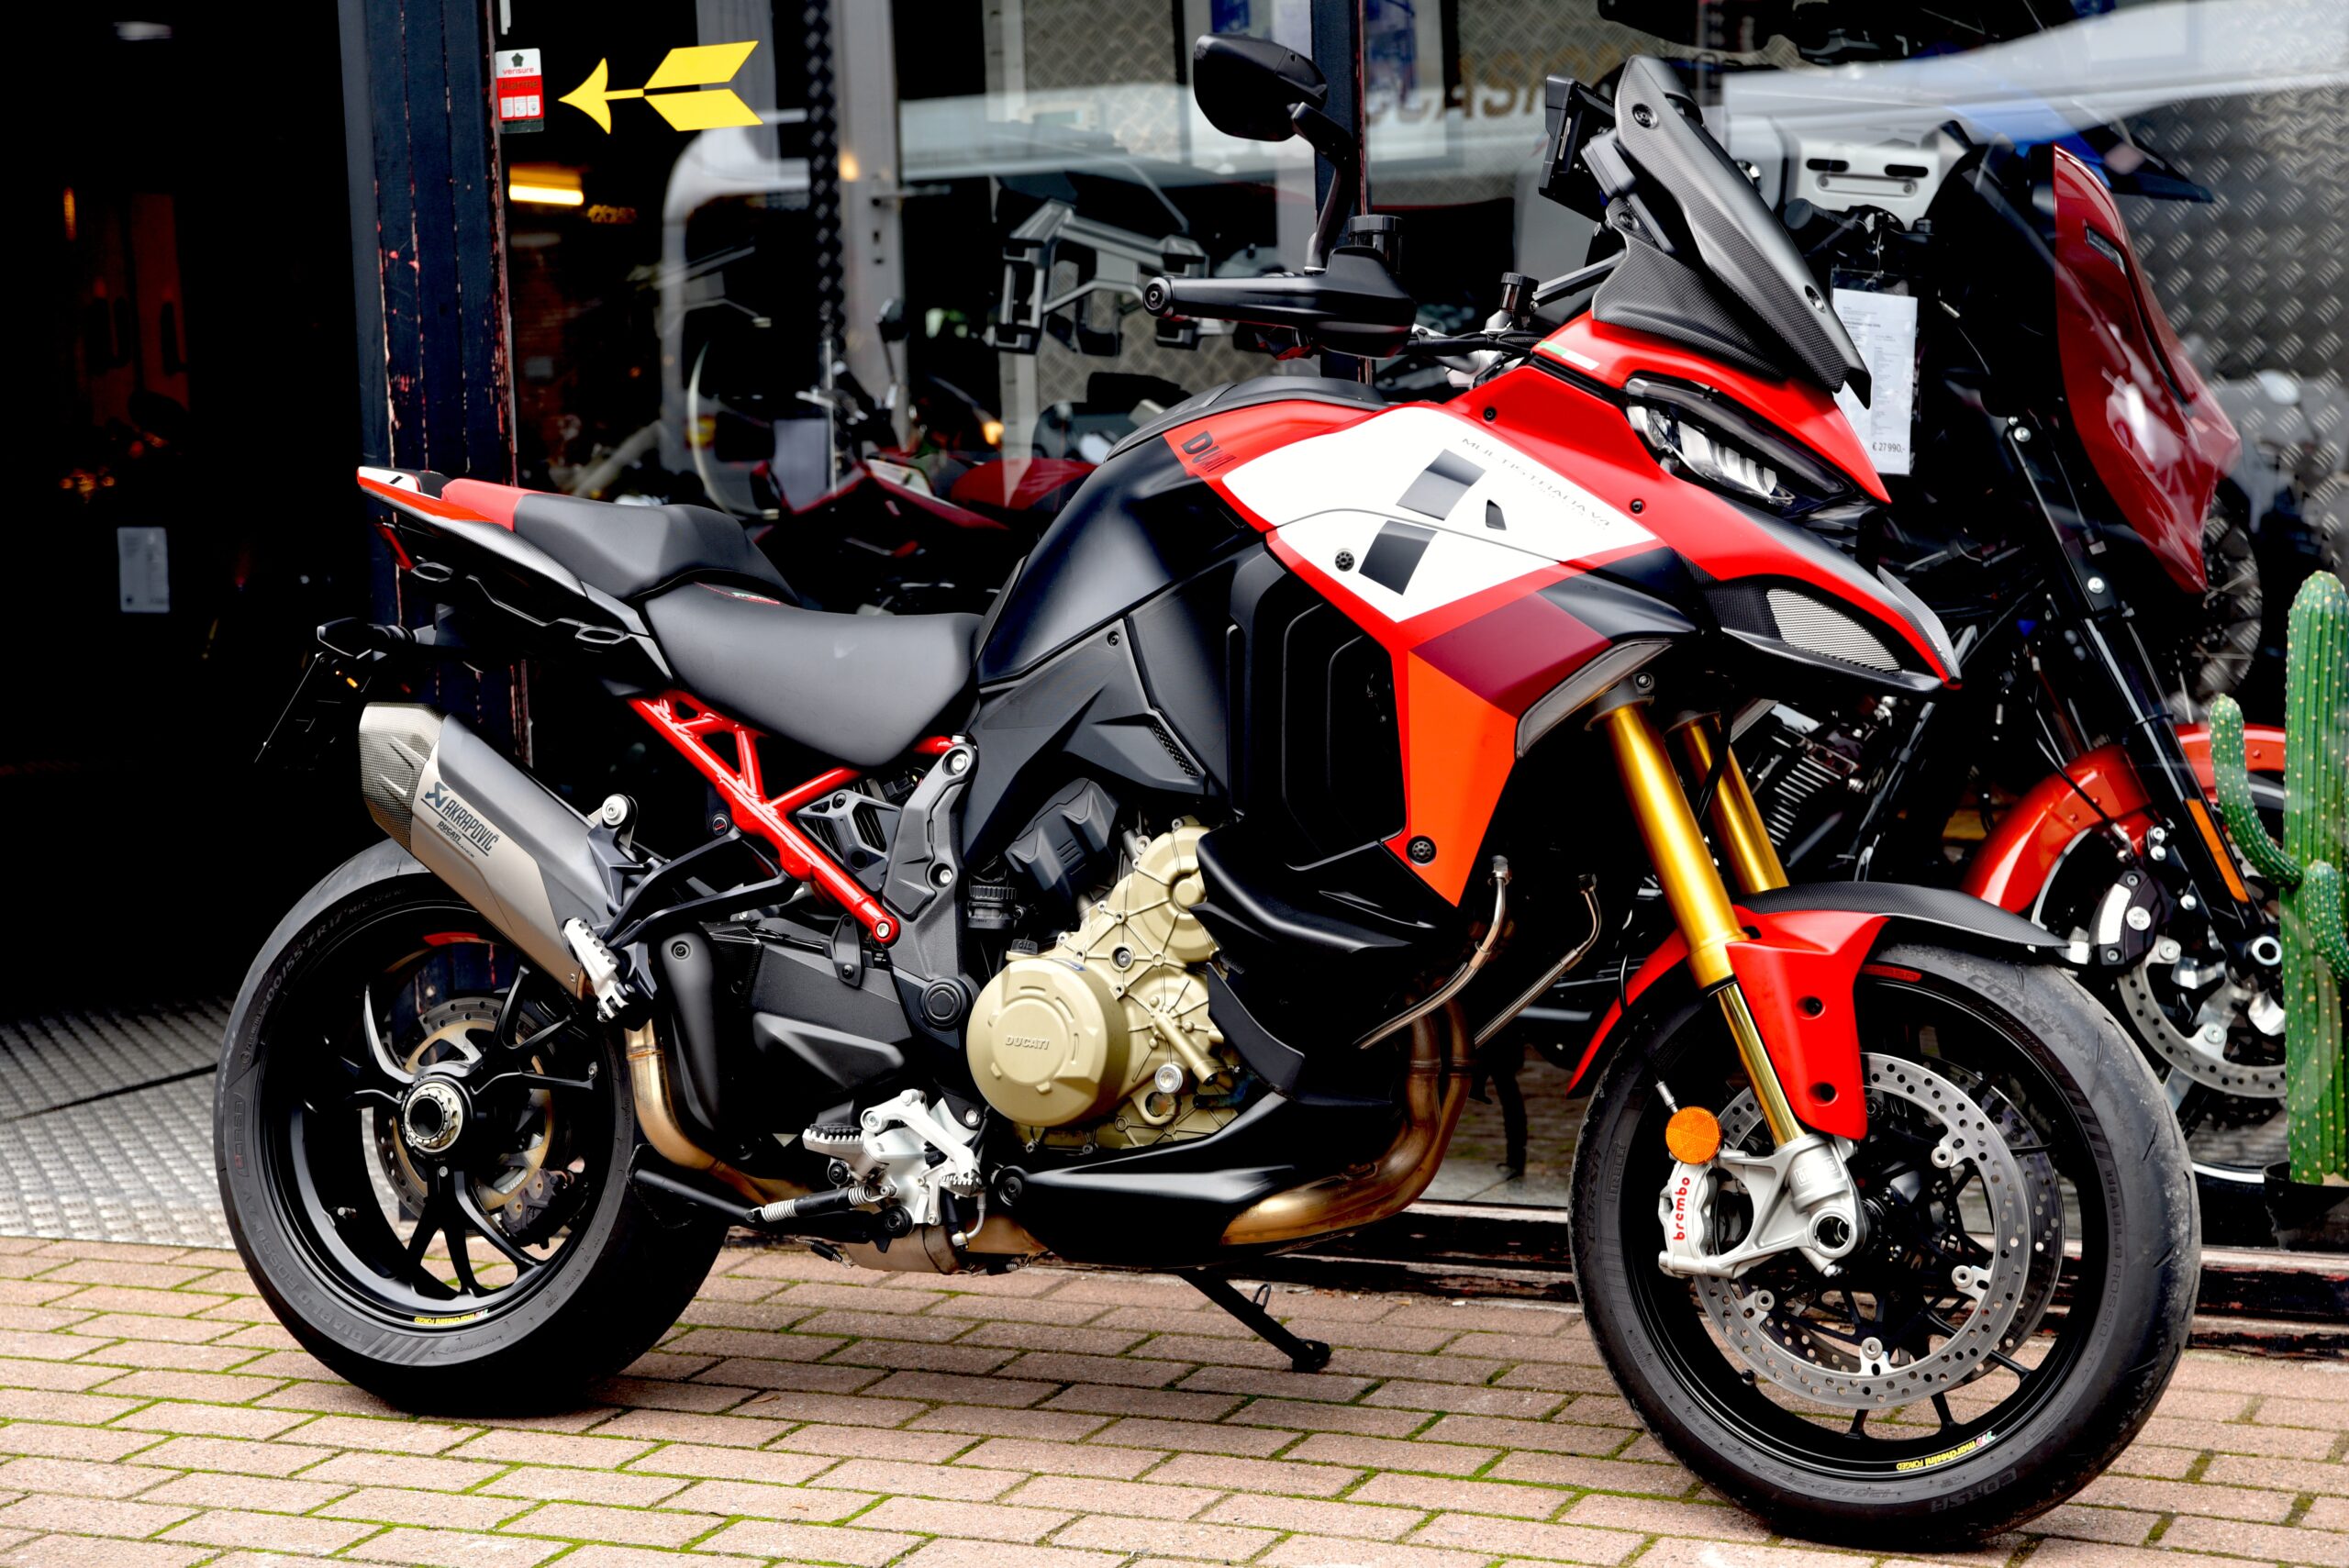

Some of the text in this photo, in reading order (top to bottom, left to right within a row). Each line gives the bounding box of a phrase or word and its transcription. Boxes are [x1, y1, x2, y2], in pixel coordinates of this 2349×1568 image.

[502, 66, 535, 75] verisure
[439, 820, 462, 841] DUCATI
[1018, 940, 1033, 951] OIL
[1966, 973, 2055, 1035] CORSA
[1006, 1035, 1050, 1051] DUCATI
[1673, 1176, 1690, 1241] brembo
[2104, 1169, 2122, 1260] DIABLO
[1896, 1440, 1976, 1471] marchesini FORGED
